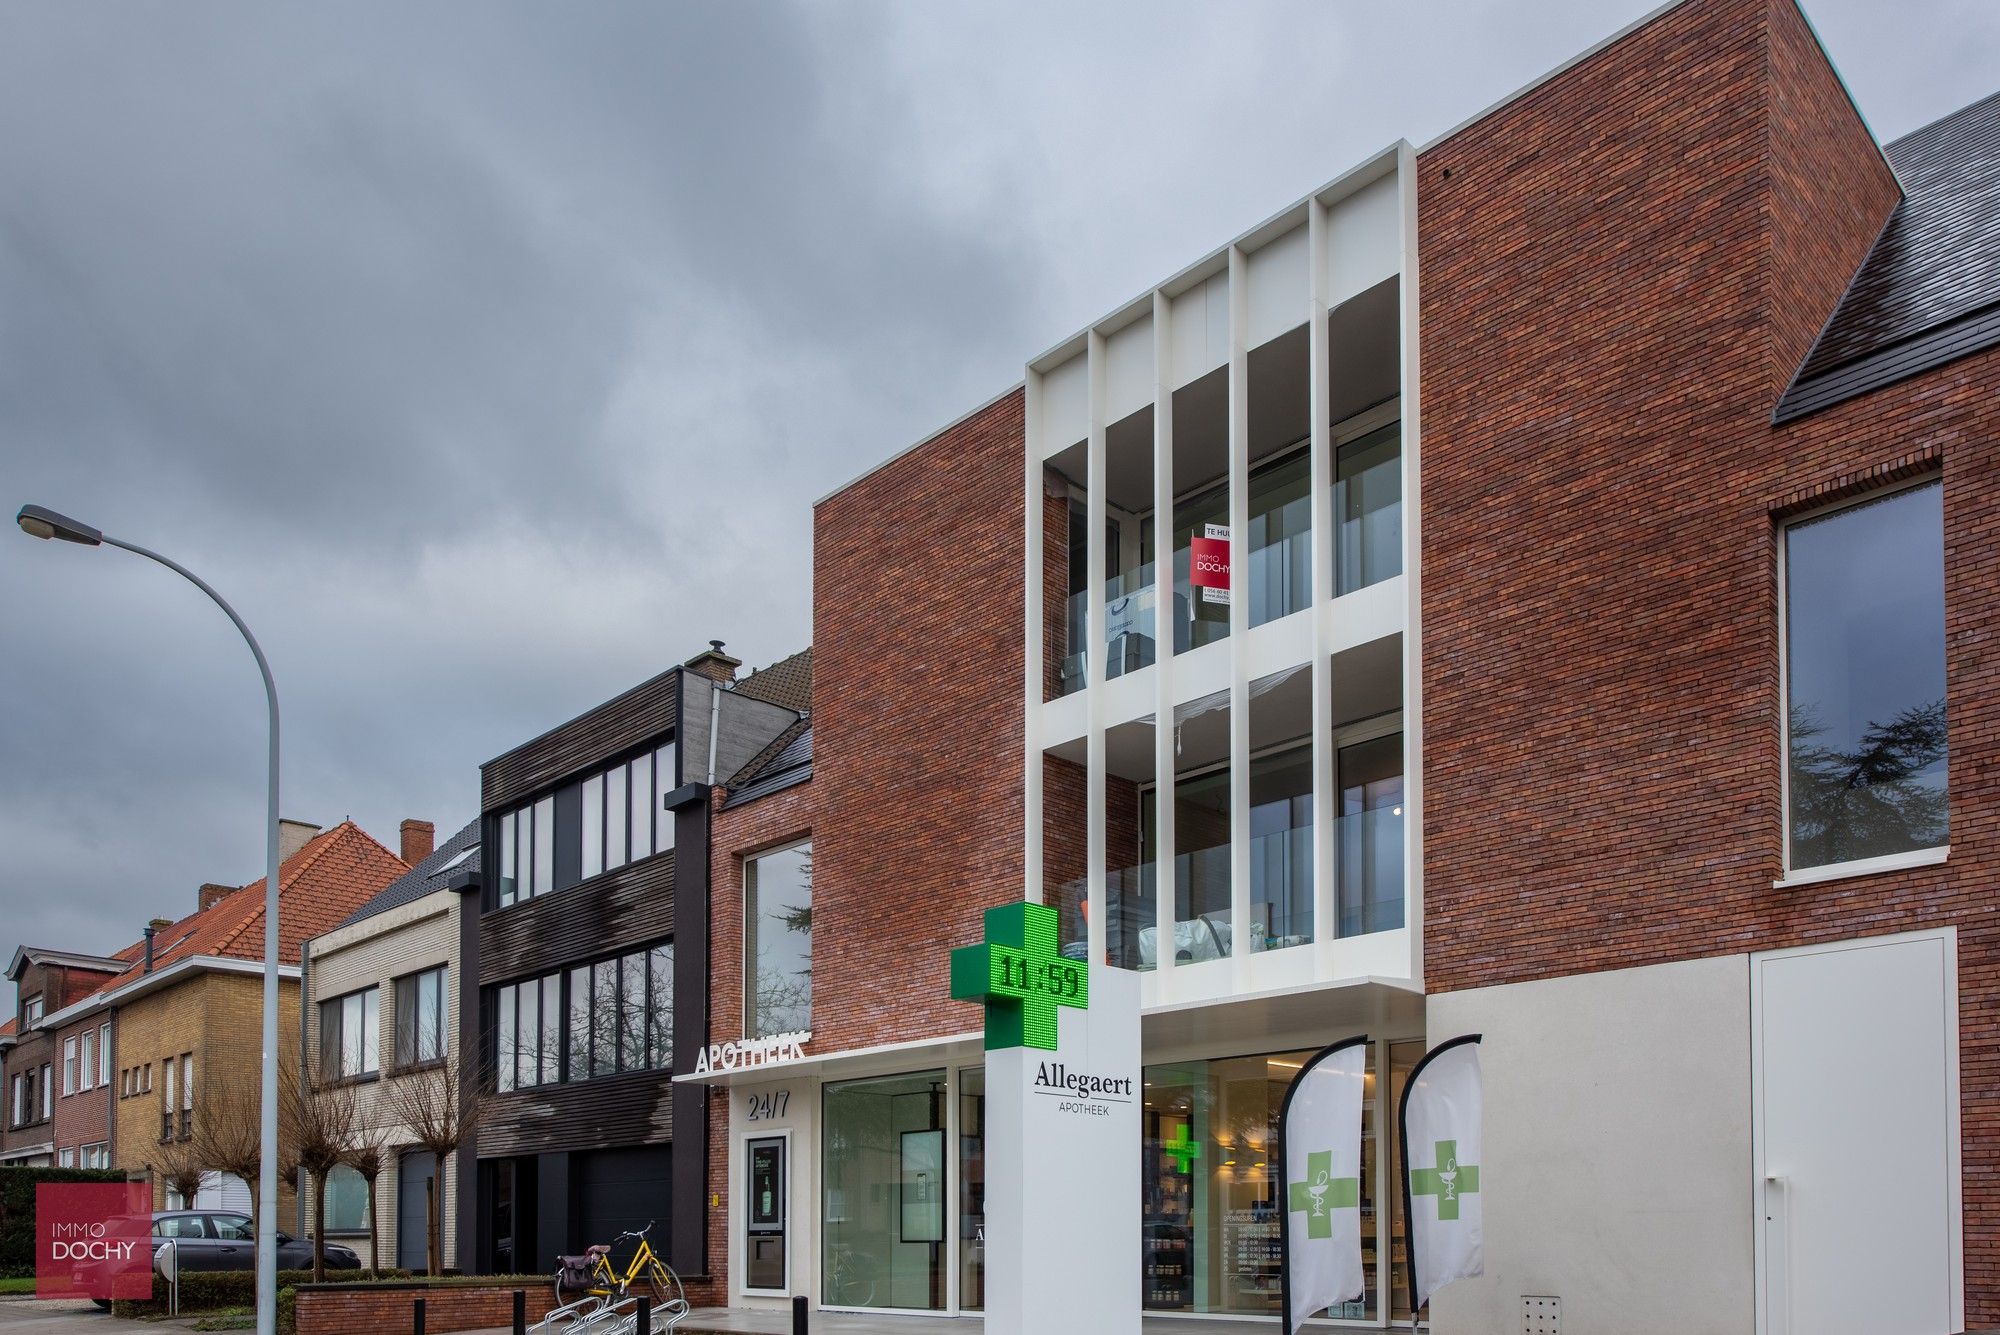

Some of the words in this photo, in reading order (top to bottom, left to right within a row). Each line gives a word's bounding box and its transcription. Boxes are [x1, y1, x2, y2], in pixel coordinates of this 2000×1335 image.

[1207, 527, 1215, 536] TE
[1197, 553, 1219, 563] IMMO
[1197, 561, 1230, 574] DOCHY
[1001, 955, 1079, 998] 11:59
[695, 1030, 812, 1073] APOTHEEK
[1034, 1061, 1132, 1099] Allegaert
[748, 1091, 790, 1121] 24/7
[1059, 1102, 1110, 1116] APOTHEEK
